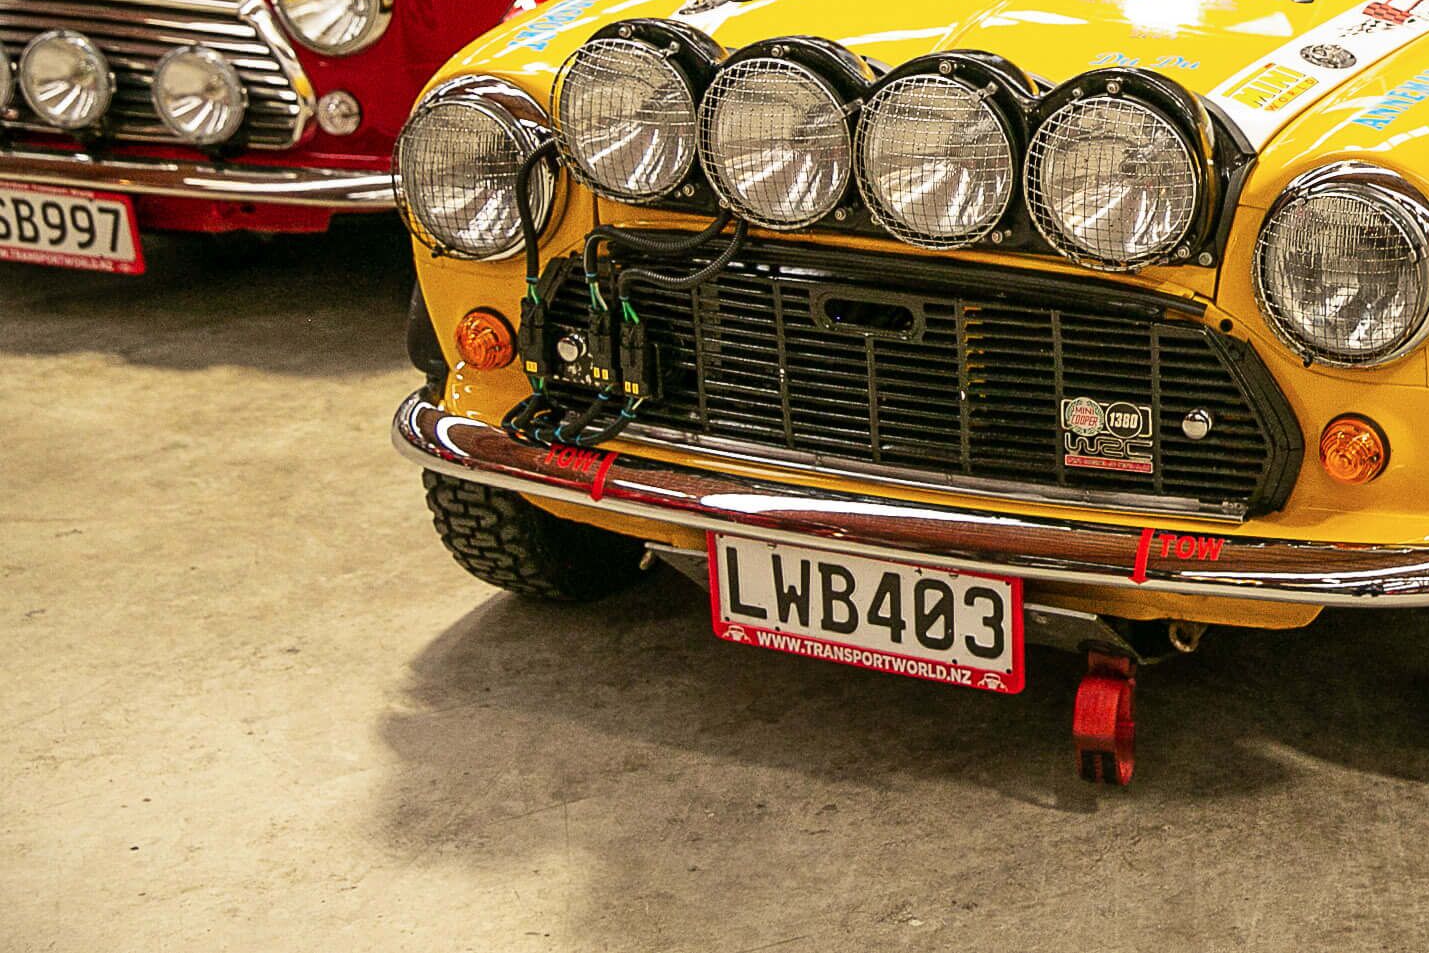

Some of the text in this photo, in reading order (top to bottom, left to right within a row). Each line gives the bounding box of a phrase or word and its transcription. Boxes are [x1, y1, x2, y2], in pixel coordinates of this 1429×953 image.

[1231, 65, 1306, 109] MINI
[1263, 77, 1317, 111] WORLD
[1071, 414, 1099, 427] COOPER
[1073, 406, 1095, 416] MINI
[544, 444, 600, 473] TOW
[1158, 532, 1226, 561] TOW
[725, 546, 1005, 660] LWB403
[755, 629, 973, 686] WWW.TRANSPORTWORLD.NZ
